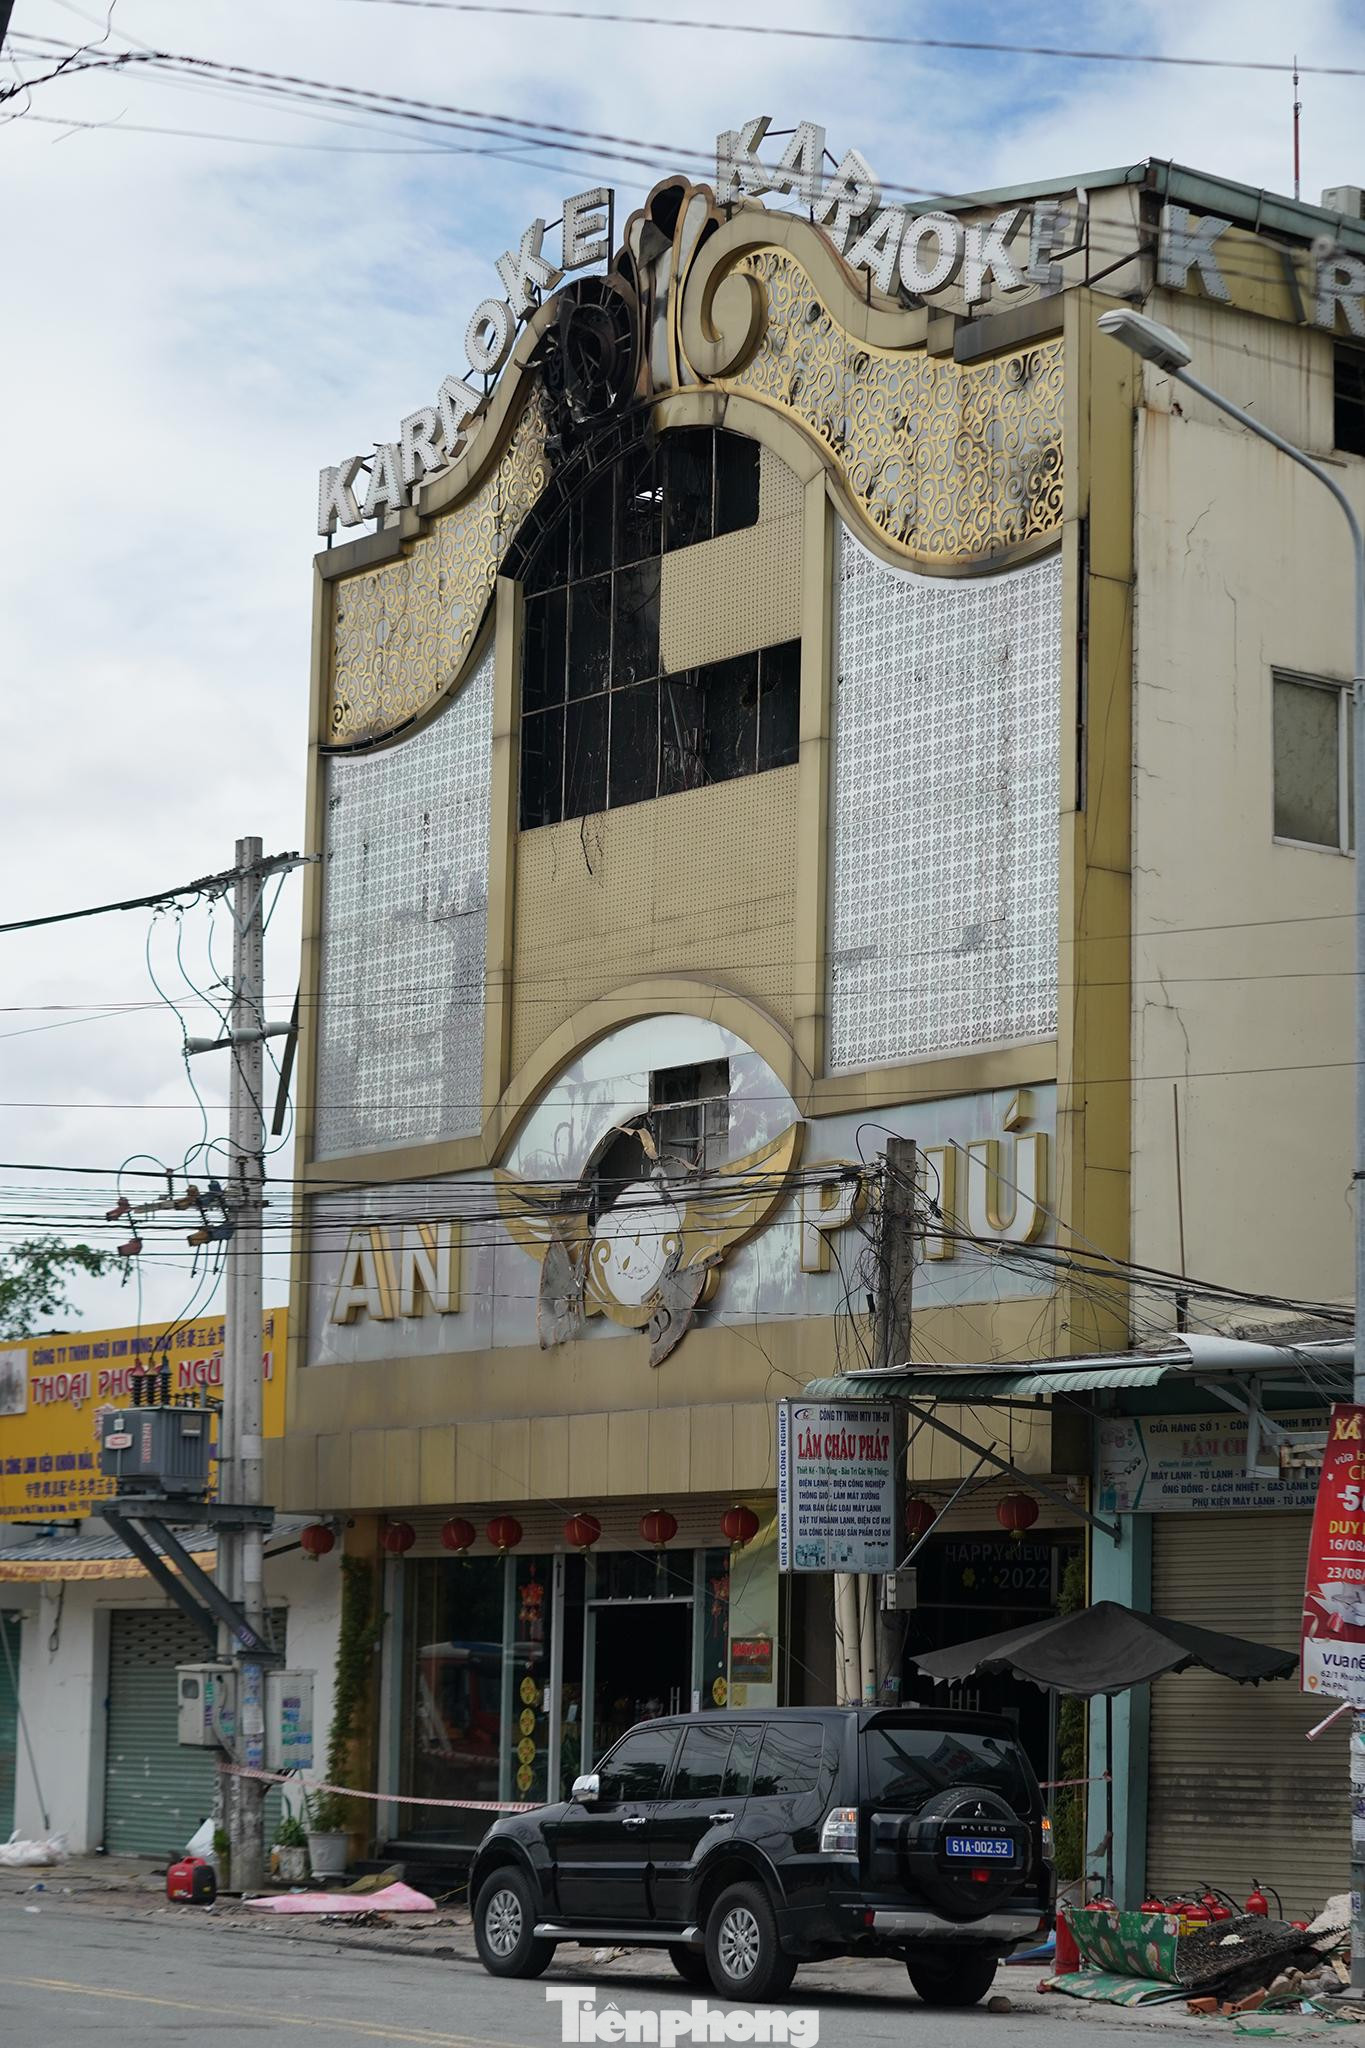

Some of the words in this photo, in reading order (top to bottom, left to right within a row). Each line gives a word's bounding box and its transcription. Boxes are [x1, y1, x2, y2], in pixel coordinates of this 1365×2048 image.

[715, 115, 1065, 305] KARAOKE
[317, 187, 610, 535] KARAOKE
[331, 1217, 461, 1324] AN
[31, 1372, 90, 1409] THOẠI
[819, 1407, 835, 1421] CÔNG
[836, 1410, 843, 1421] TY
[844, 1410, 859, 1421] TNHH
[780, 1410, 788, 1447] NGHIỆP
[1149, 1420, 1169, 1434] CỬA
[1171, 1422, 1197, 1433] HÀNG
[1199, 1418, 1212, 1432] SỐ
[1215, 1422, 1220, 1431] 1
[1230, 1419, 1249, 1431] CÔN
[1302, 1417, 1321, 1427] MTV
[1333, 1413, 1361, 1440] XẢ
[798, 1426, 822, 1460] LÂM
[824, 1427, 856, 1461] CHÂU
[858, 1428, 890, 1462] PHÁT
[779, 1449, 788, 1476] CÔNG
[1151, 1470, 1169, 1480] MÁY
[1171, 1471, 1192, 1482] LẠNH
[1200, 1468, 1210, 1479] TỦ
[1212, 1470, 1233, 1481] LẠNH
[799, 1479, 812, 1488] ĐIỆN
[813, 1480, 829, 1489] LẠNH
[834, 1479, 847, 1489] ĐIỆN
[848, 1479, 863, 1488] CÔNG
[865, 1480, 886, 1489] NGHIỆP
[1162, 1482, 1180, 1494] ỐNG
[1181, 1482, 1204, 1494] ĐỒNG
[1211, 1482, 1233, 1493] CÁCH
[1236, 1481, 1259, 1493] NHIỆT
[1267, 1482, 1284, 1491] GAS
[1286, 1482, 1308, 1494] LẠNH
[799, 1490, 818, 1500] THÔNG
[847, 1490, 859, 1500] MÁT
[1192, 1497, 1208, 1508] PHỤ
[1211, 1496, 1231, 1507] KIỆN
[1233, 1495, 1247, 1506] MÁY
[1252, 1496, 1275, 1507] LẠNH
[1283, 1494, 1294, 1505] TỦ
[799, 1504, 812, 1512] MUA
[813, 1503, 825, 1512] BÁN
[826, 1503, 838, 1512] CÁC
[838, 1504, 851, 1514] LOẠI
[852, 1503, 865, 1513] MÁY
[866, 1504, 882, 1514] LẠNH
[780, 1513, 789, 1538] LẠNH
[799, 1515, 809, 1526] VẬT
[811, 1515, 818, 1524] TƯ
[819, 1515, 839, 1524] NGÀNH
[857, 1515, 871, 1525] ĐIỆN
[1329, 1520, 1359, 1535] DUY
[799, 1528, 808, 1537] GIA
[809, 1527, 823, 1537] CÔNG
[824, 1528, 834, 1537] CÁC
[835, 1529, 847, 1538] LOẠI
[847, 1527, 858, 1537] SẢN
[999, 1568, 1050, 1589] 2022
